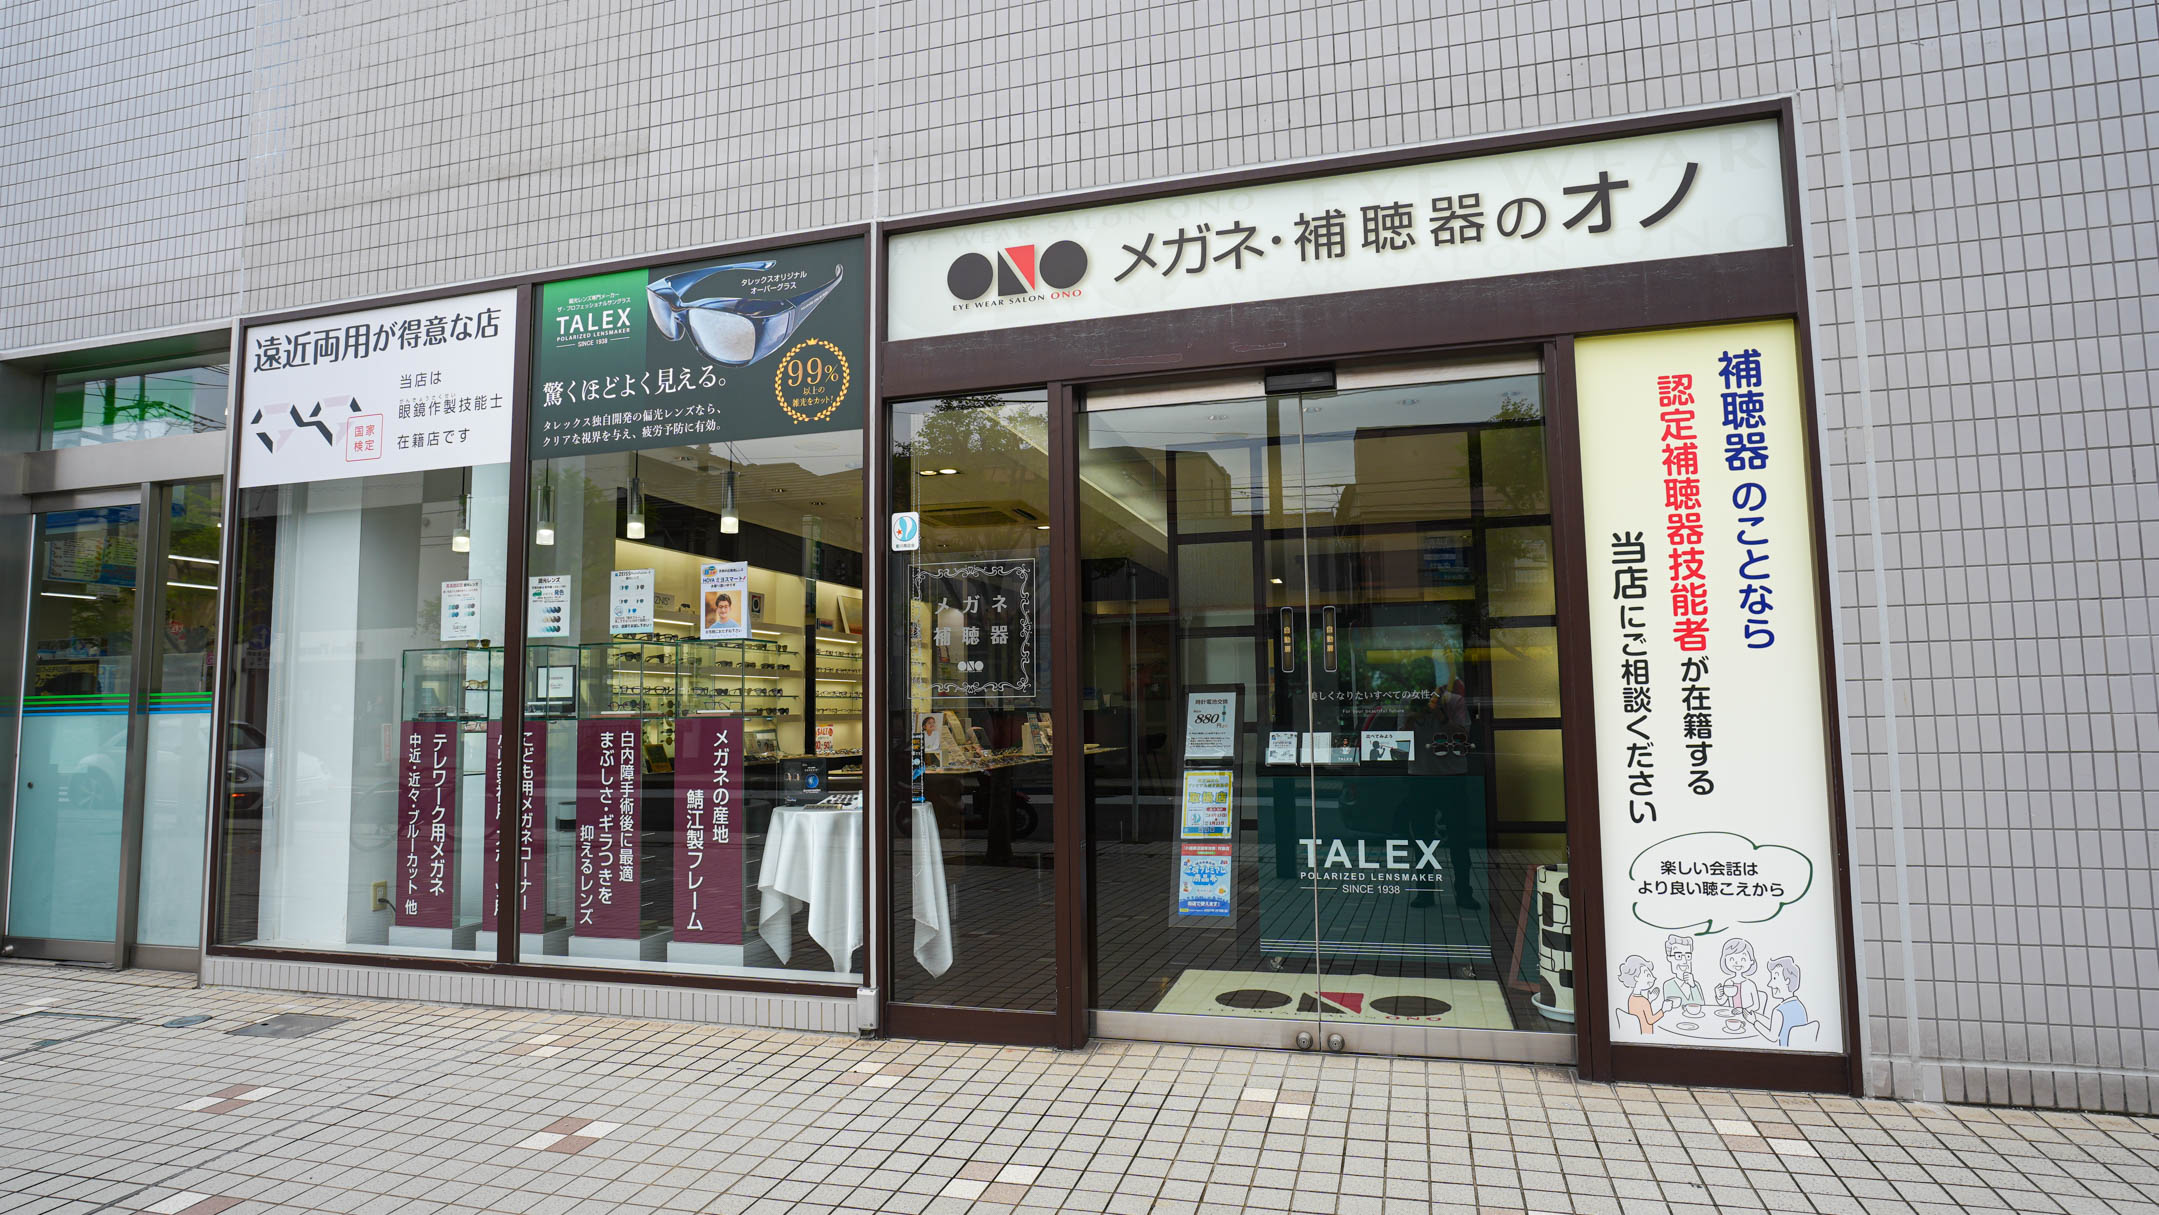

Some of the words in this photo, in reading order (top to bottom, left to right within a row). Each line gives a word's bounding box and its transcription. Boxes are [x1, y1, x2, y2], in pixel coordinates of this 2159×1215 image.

[1113, 161, 1701, 283] メガネ・補聴器のオノ
[741, 271, 808, 287] タレックスオリジナル
[750, 282, 797, 295] オーバーグラス
[953, 301, 970, 311] EYE
[974, 299, 1004, 309] WEAR
[1009, 294, 1046, 304] SALON
[1050, 289, 1083, 300] ONO
[556, 307, 632, 335] TALEX
[253, 308, 502, 373] 遠近両用が得意な店
[556, 332, 592, 342] POLARIZED
[593, 328, 631, 337] LENSMAKER
[577, 339, 594, 348] SINCE
[400, 370, 442, 390] 当店は
[542, 364, 727, 407] 驚くほどよく見える。
[787, 357, 839, 387] 99%
[802, 386, 825, 396] 以上の
[398, 393, 503, 420] 眼鏡作製技能士
[542, 404, 722, 432] タレックス独自開発の偏光レンズなら、
[354, 424, 376, 438] 国家
[397, 428, 471, 450] 在籍店です
[542, 421, 722, 448] クリアな視界を与え、疲労予防に有効。
[353, 439, 375, 453] 検定
[1717, 348, 1776, 650] 補聴器のことなら
[1657, 373, 1716, 796] 認定補聴器技能者が在籍する
[935, 595, 1008, 615] メガネ
[933, 625, 1009, 646] 補聴器
[1611, 530, 1657, 824] 当店にご相談ください
[1195, 713, 1219, 724] 880
[712, 729, 730, 844] メガネの産地
[407, 733, 422, 895] 中近・近々・ブルーカット
[429, 733, 448, 896] テレワーク用メガネ
[598, 731, 615, 905] まぶしさ・ギラつきを
[619, 730, 635, 883] 白内障手術後に最適
[520, 731, 534, 911] こども用メガネコーナー
[686, 789, 704, 931] 鯖江製フレーム
[1299, 839, 1443, 870] TALEX
[1660, 860, 1759, 876] 楽しい会話は
[580, 825, 595, 925] 抑えるレンズ
[1300, 871, 1365, 881] POLARIZED
[1371, 873, 1443, 882] LENSMAKER
[1342, 884, 1374, 894] SINCE
[1377, 885, 1400, 894] 1938
[1638, 881, 1786, 897] より良い聴こえから
[405, 899, 418, 916] 他
